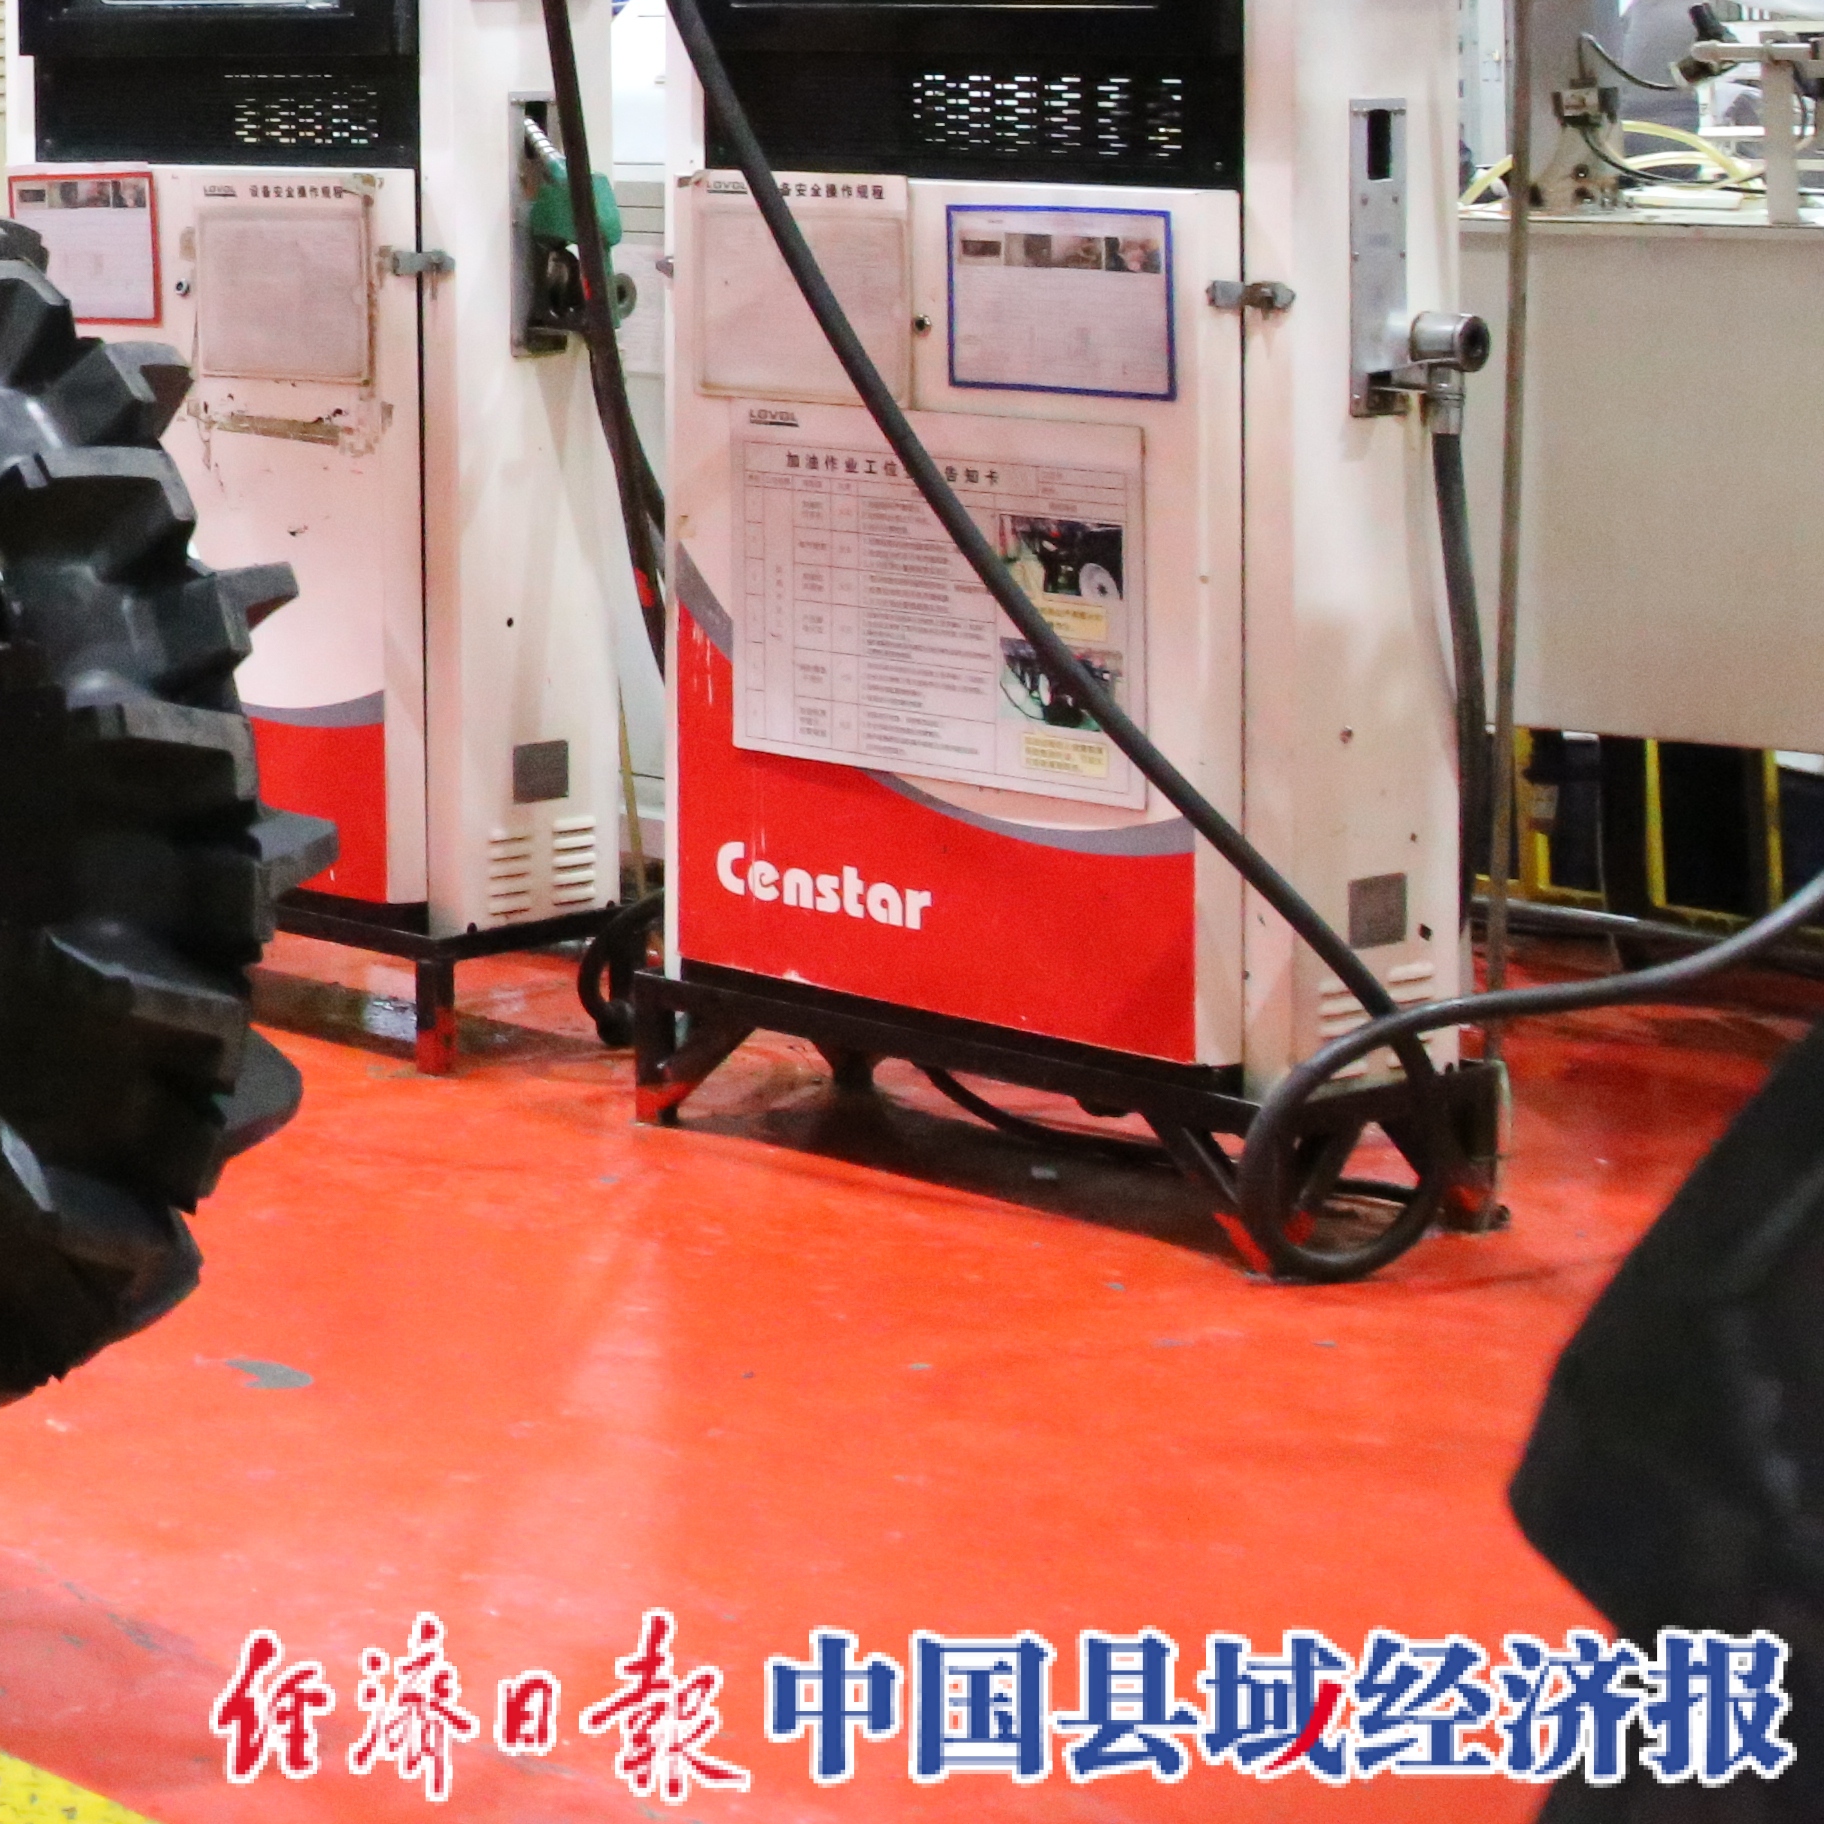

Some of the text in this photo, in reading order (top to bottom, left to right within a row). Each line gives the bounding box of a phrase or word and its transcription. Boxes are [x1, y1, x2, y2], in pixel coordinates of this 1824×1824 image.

[203, 185, 236, 194] LOVOL
[706, 180, 747, 190] LOVOL
[779, 181, 885, 200] 备安全操作规程
[748, 408, 799, 423] LOVOL
[785, 449, 1000, 486] 加油作业工位告知卡
[716, 840, 933, 931] Censtar
